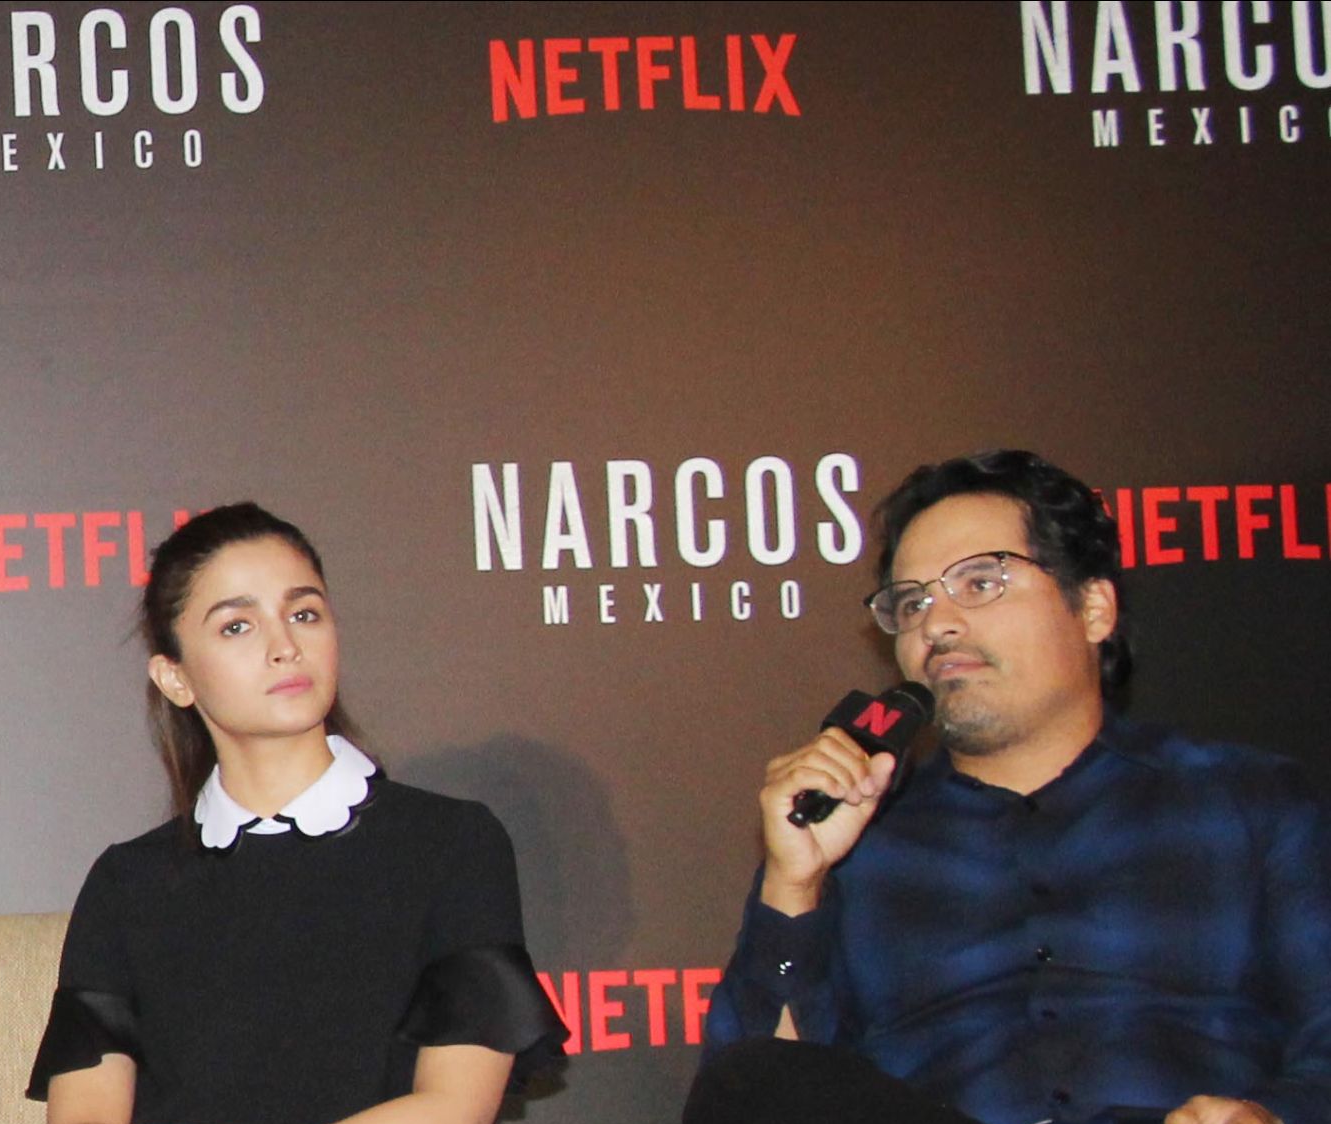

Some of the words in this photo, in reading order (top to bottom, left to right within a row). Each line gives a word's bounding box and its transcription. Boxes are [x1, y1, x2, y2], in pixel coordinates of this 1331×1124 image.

[488, 33, 802, 123] NETFLIX
[1092, 105, 1331, 148] MEXIC
[472, 453, 862, 571] NARCOS
[542, 580, 800, 625] MEXICO
[852, 700, 904, 738] N
